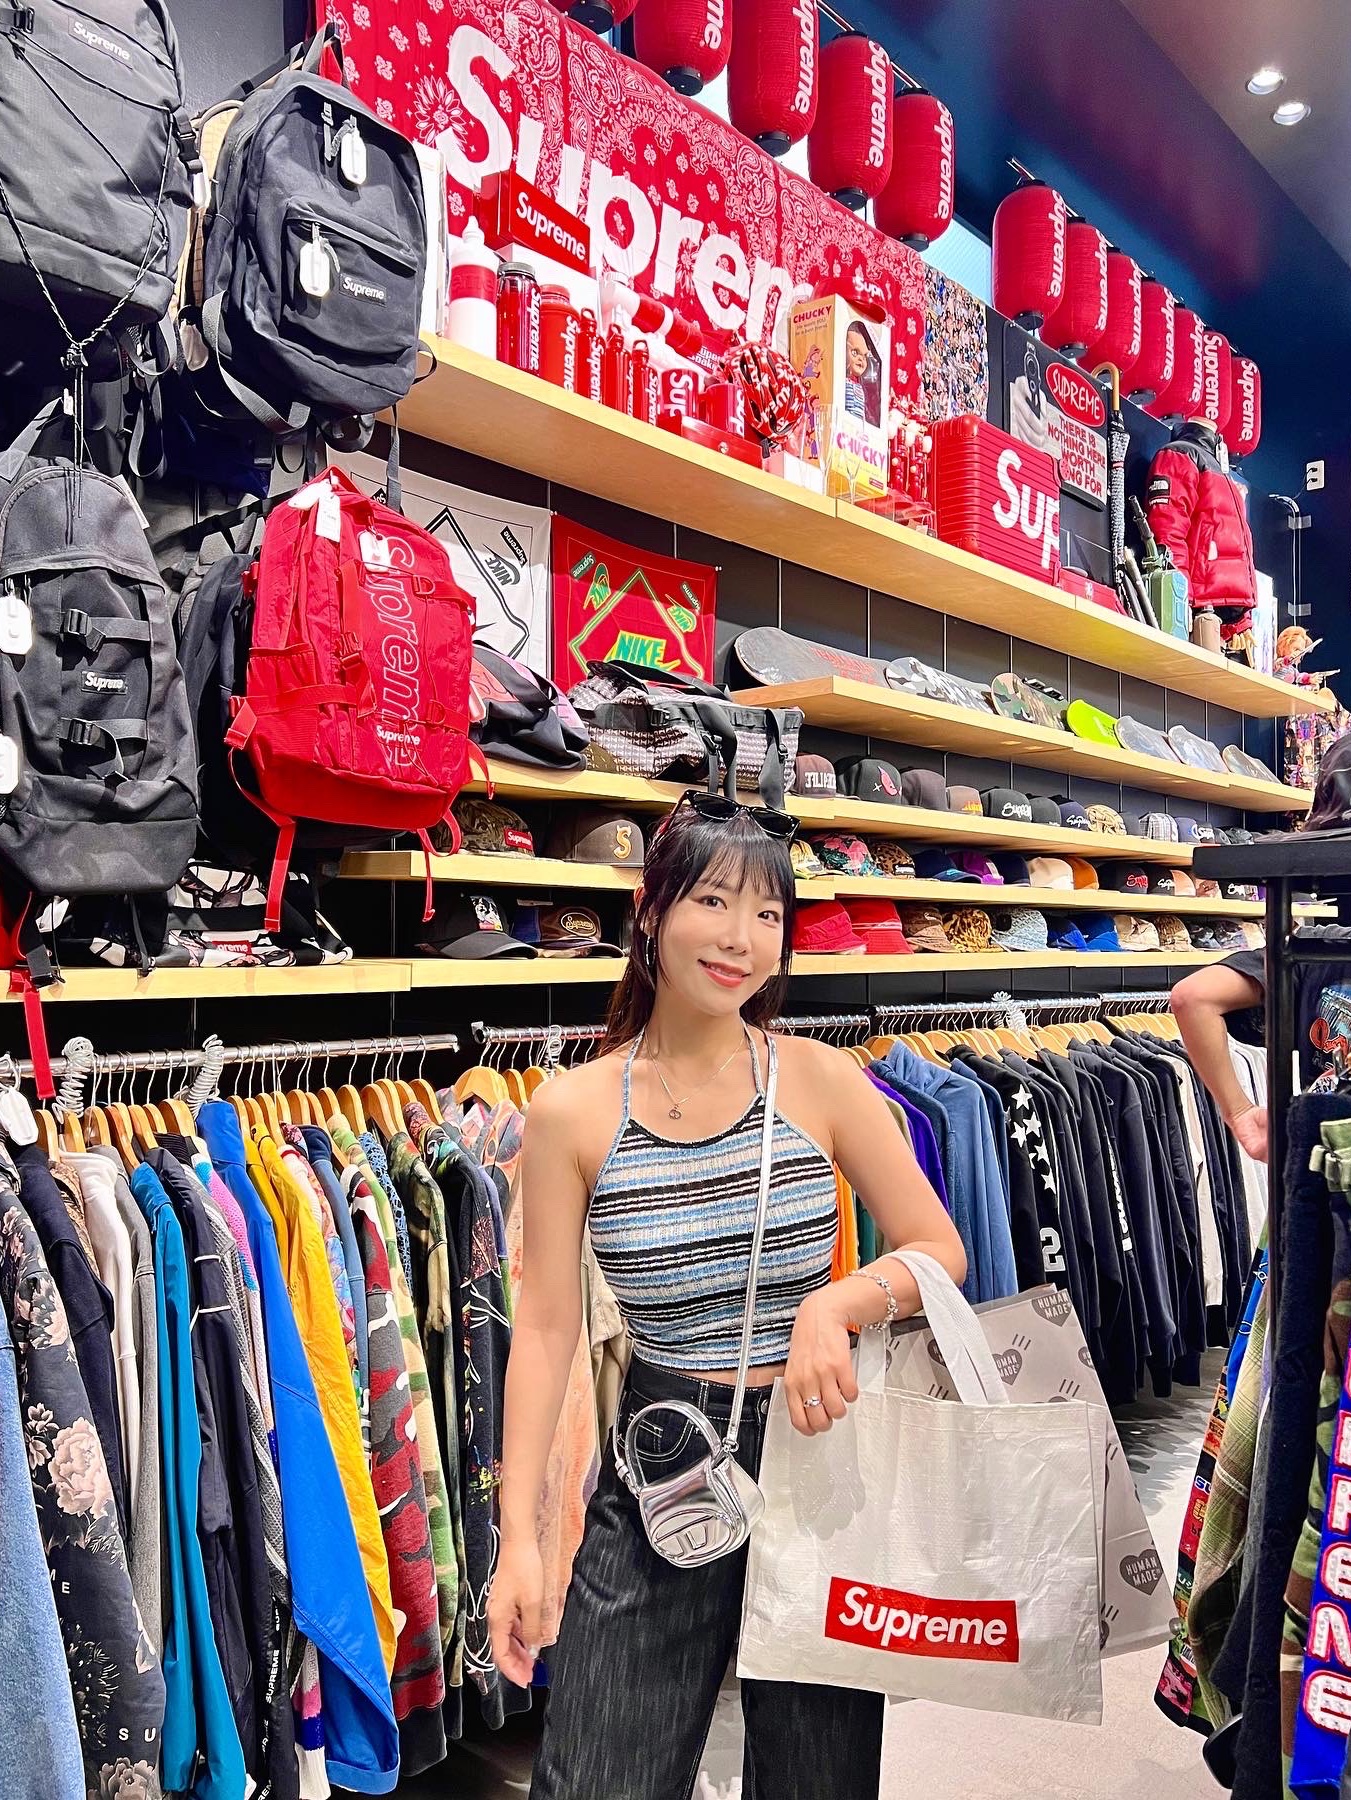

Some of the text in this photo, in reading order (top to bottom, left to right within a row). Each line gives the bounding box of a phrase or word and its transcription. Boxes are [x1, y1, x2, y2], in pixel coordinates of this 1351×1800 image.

[73, 21, 131, 60] Supreme
[863, 40, 891, 168] Supreme
[933, 100, 954, 220] Supreme
[515, 191, 586, 261] Supreme
[1048, 189, 1067, 298] Supreme
[342, 276, 386, 300] Supreme
[527, 287, 541, 371] Supreme
[793, 305, 832, 324] CHUCKY
[1160, 287, 1176, 381] Supreme
[1189, 314, 1205, 403] Supreme
[1203, 334, 1223, 420] Supreme
[1052, 368, 1100, 420] SUPREME
[1237, 360, 1259, 441] Supreme
[1047, 422, 1106, 469] NOTHING HERE
[1059, 415, 1096, 448] THERE IS
[1061, 449, 1096, 474] WORTH
[1084, 475, 1103, 498] FOR
[485, 555, 513, 586] NIKE
[503, 530, 526, 566] Supreme
[614, 632, 666, 667] NIKE
[85, 671, 124, 691] Supreme
[613, 825, 632, 859] S
[1040, 1227, 1067, 1273] 2
[1037, 1291, 1069, 1309] HUMAN
[1126, 1557, 1158, 1576] HUMAN
[838, 1586, 1008, 1647] Supreme
[265, 1649, 280, 1704] SUPREME
